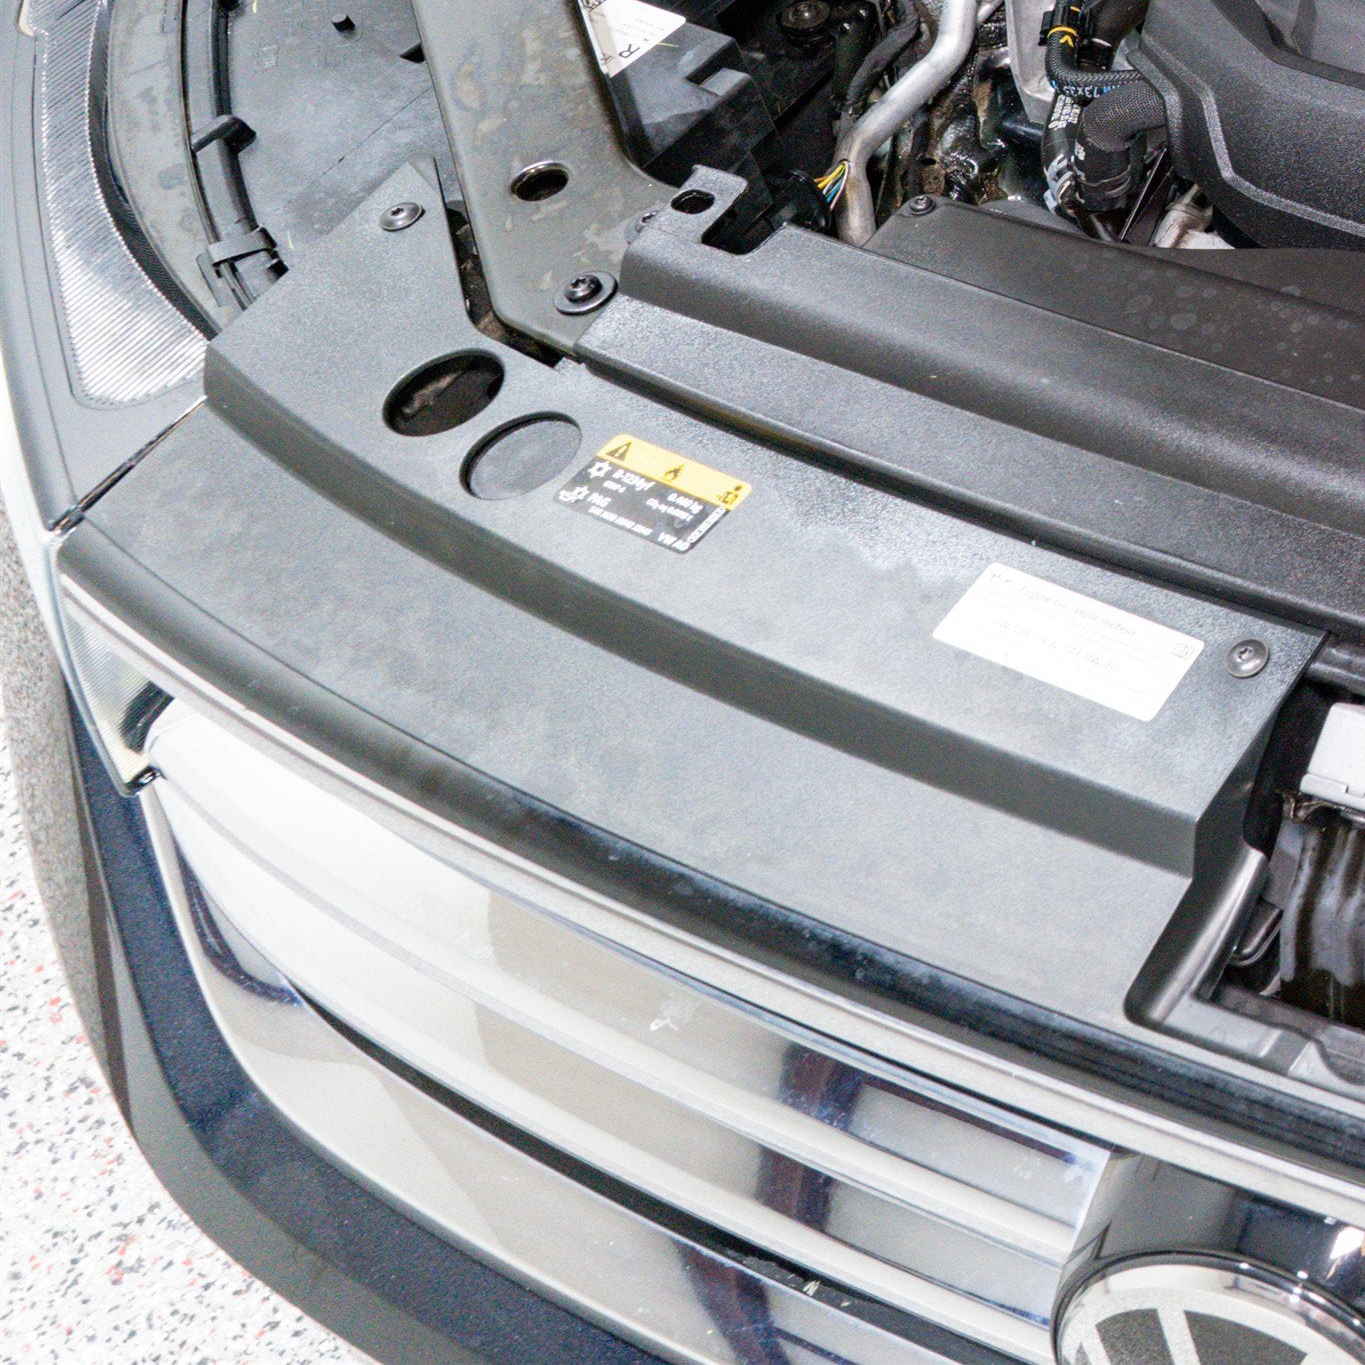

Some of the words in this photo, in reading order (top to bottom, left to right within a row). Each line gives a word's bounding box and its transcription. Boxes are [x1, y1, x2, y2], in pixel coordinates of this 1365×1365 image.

[619, 44, 641, 59] R
[587, 493, 612, 507] PAG
[692, 503, 704, 513] kg
[658, 533, 674, 544] VW
[674, 539, 690, 551] AG
[1074, 608, 1099, 620] Huile
[1100, 618, 1137, 635] moteur
